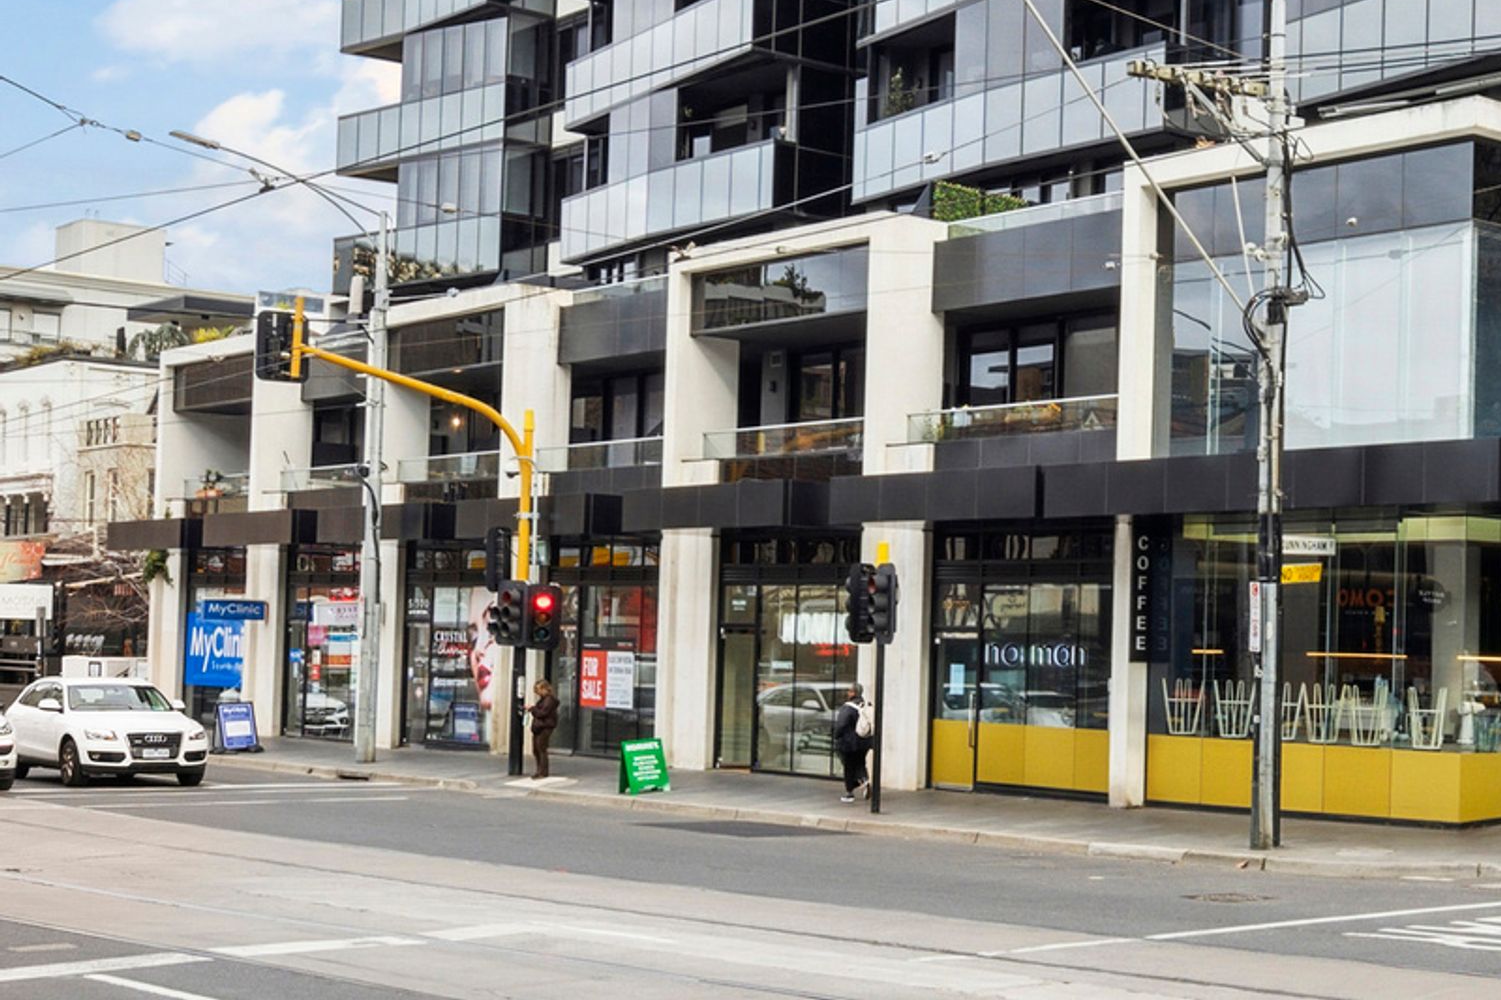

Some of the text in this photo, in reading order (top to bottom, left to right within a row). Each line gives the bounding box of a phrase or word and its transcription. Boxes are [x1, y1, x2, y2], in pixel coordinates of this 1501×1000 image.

[1135, 535, 1149, 651] COFFEE
[208, 602, 260, 616] MyClinic
[582, 656, 599, 677] FOR
[582, 679, 603, 700] SALE
